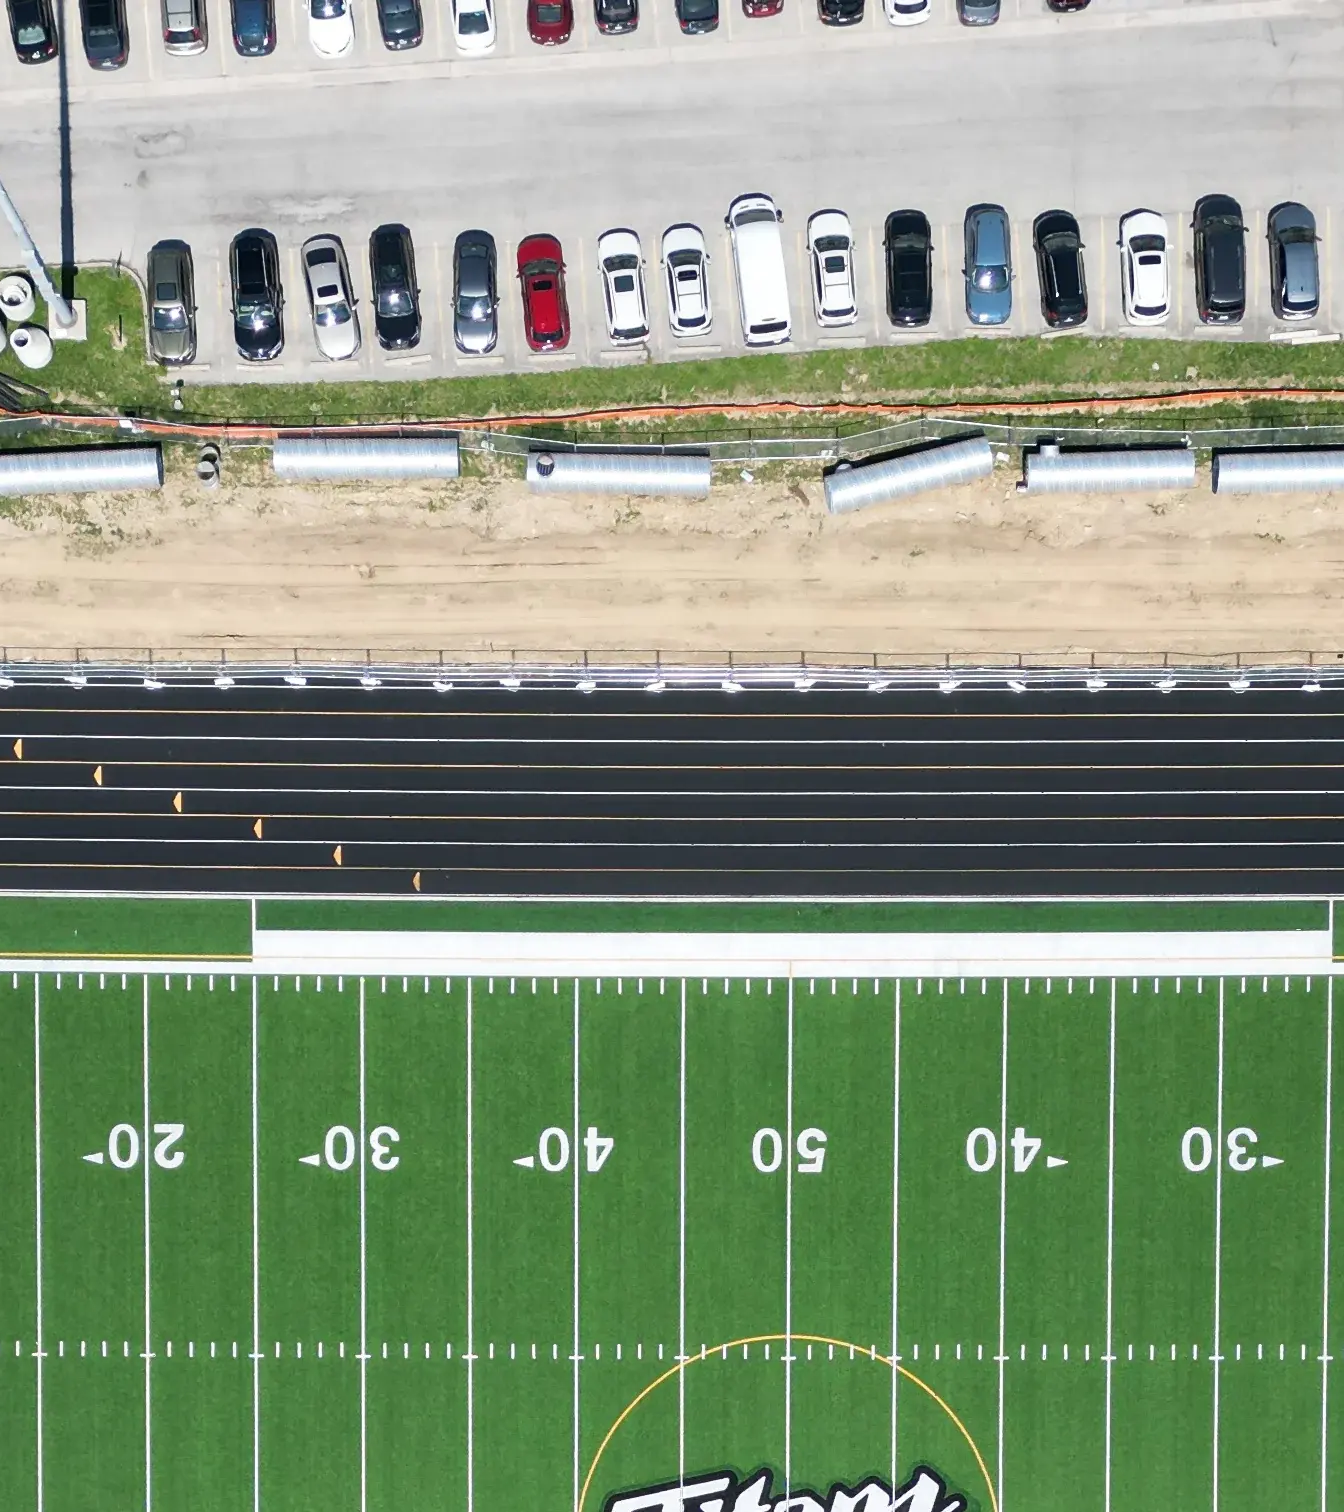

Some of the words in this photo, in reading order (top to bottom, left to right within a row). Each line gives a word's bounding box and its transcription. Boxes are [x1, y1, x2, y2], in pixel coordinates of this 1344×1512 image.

[108, 1123, 185, 1169] 20
[324, 1125, 400, 1171] 30
[538, 1126, 614, 1172] 40
[752, 1127, 828, 1173] 50
[966, 1127, 1042, 1173] 40
[1181, 1126, 1258, 1172] 30
